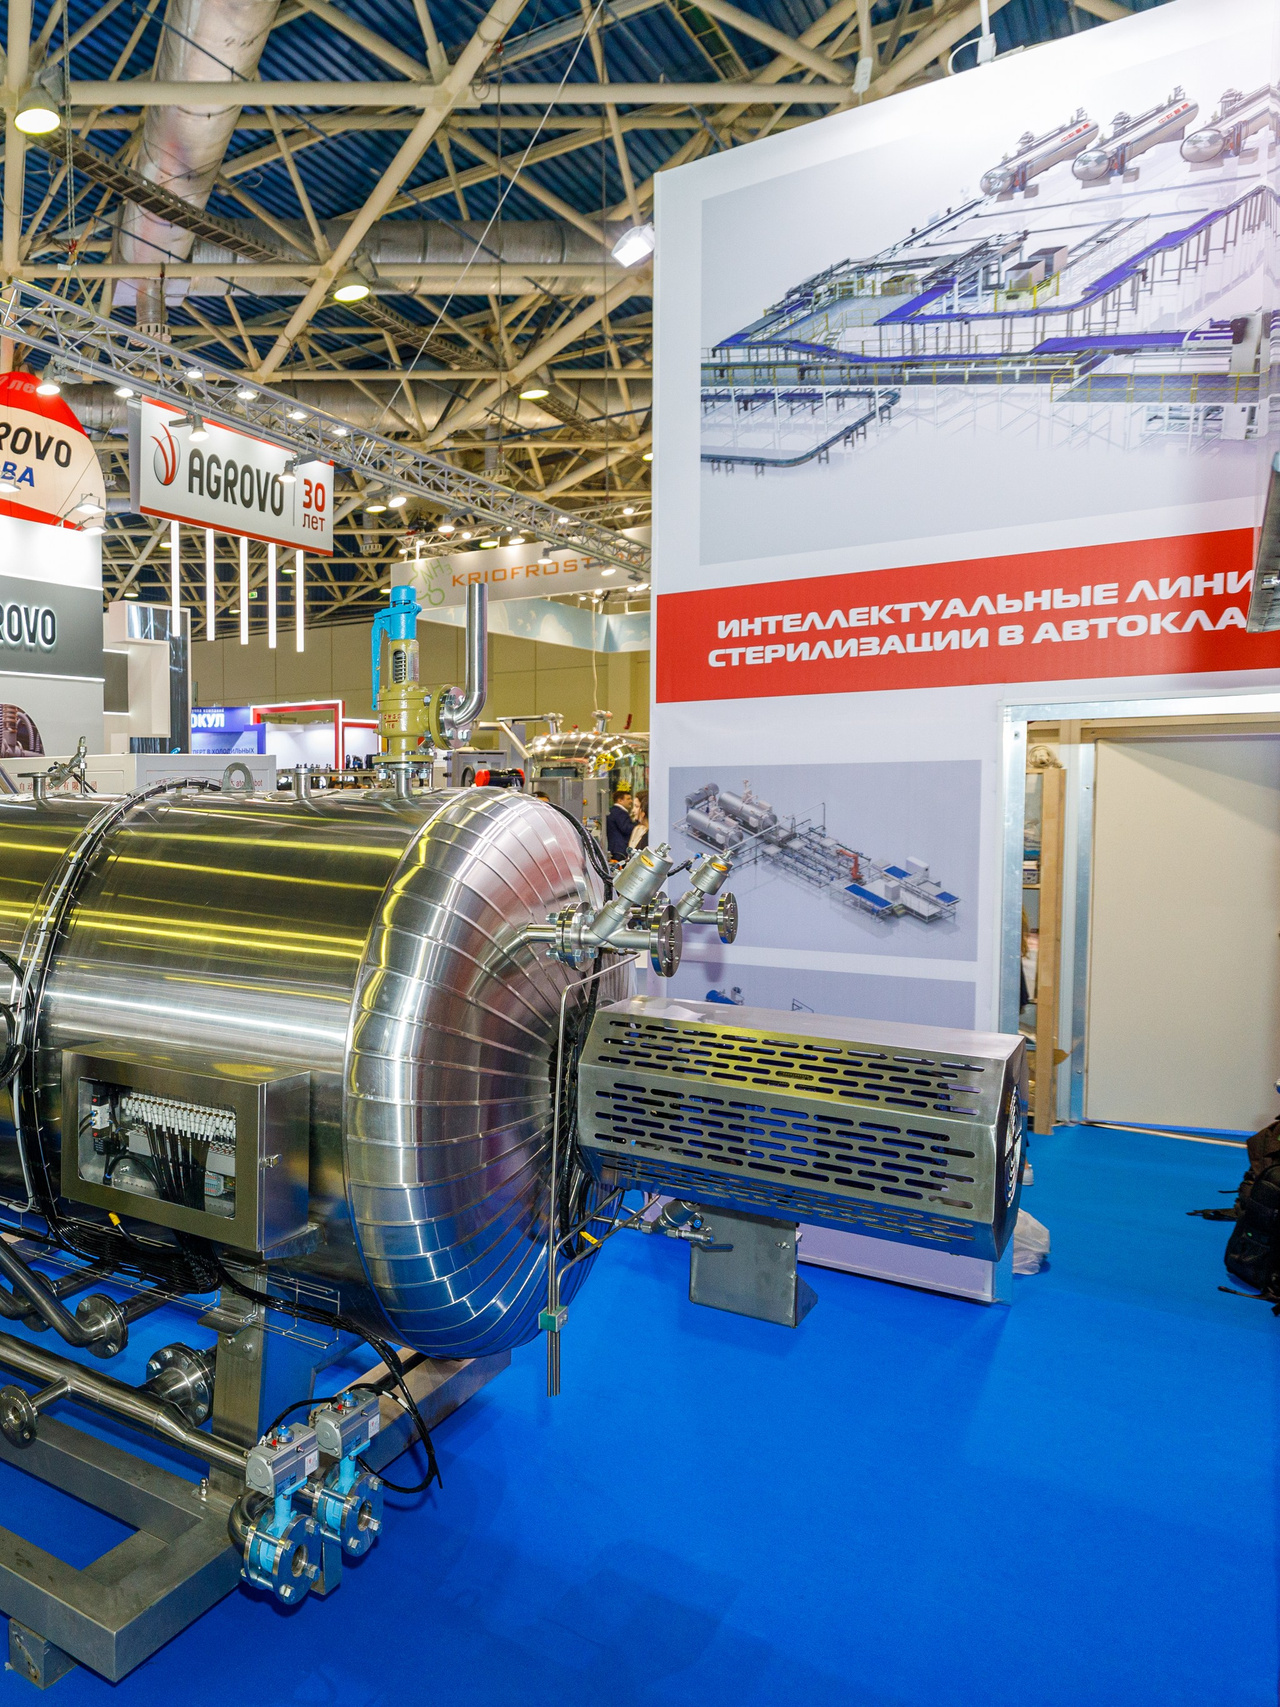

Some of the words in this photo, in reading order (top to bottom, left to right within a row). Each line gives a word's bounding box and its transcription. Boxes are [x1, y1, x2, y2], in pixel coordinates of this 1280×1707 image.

[7, 379, 36, 394] ле
[188, 448, 285, 516] AGROVO
[303, 478, 326, 513] 30
[302, 512, 326, 532] лет
[452, 557, 594, 587] KRIOFROST
[717, 582, 1119, 638] ИНТЕЛЛЕКТУАЛЬНЫЕ
[1125, 569, 1255, 603] ЛИНИ
[708, 627, 989, 668] СТЕРИЛИЗАЦИИ
[998, 624, 1025, 646] В
[1031, 606, 1248, 644] АВТОКЛА
[191, 713, 225, 728] ОКУЛ
